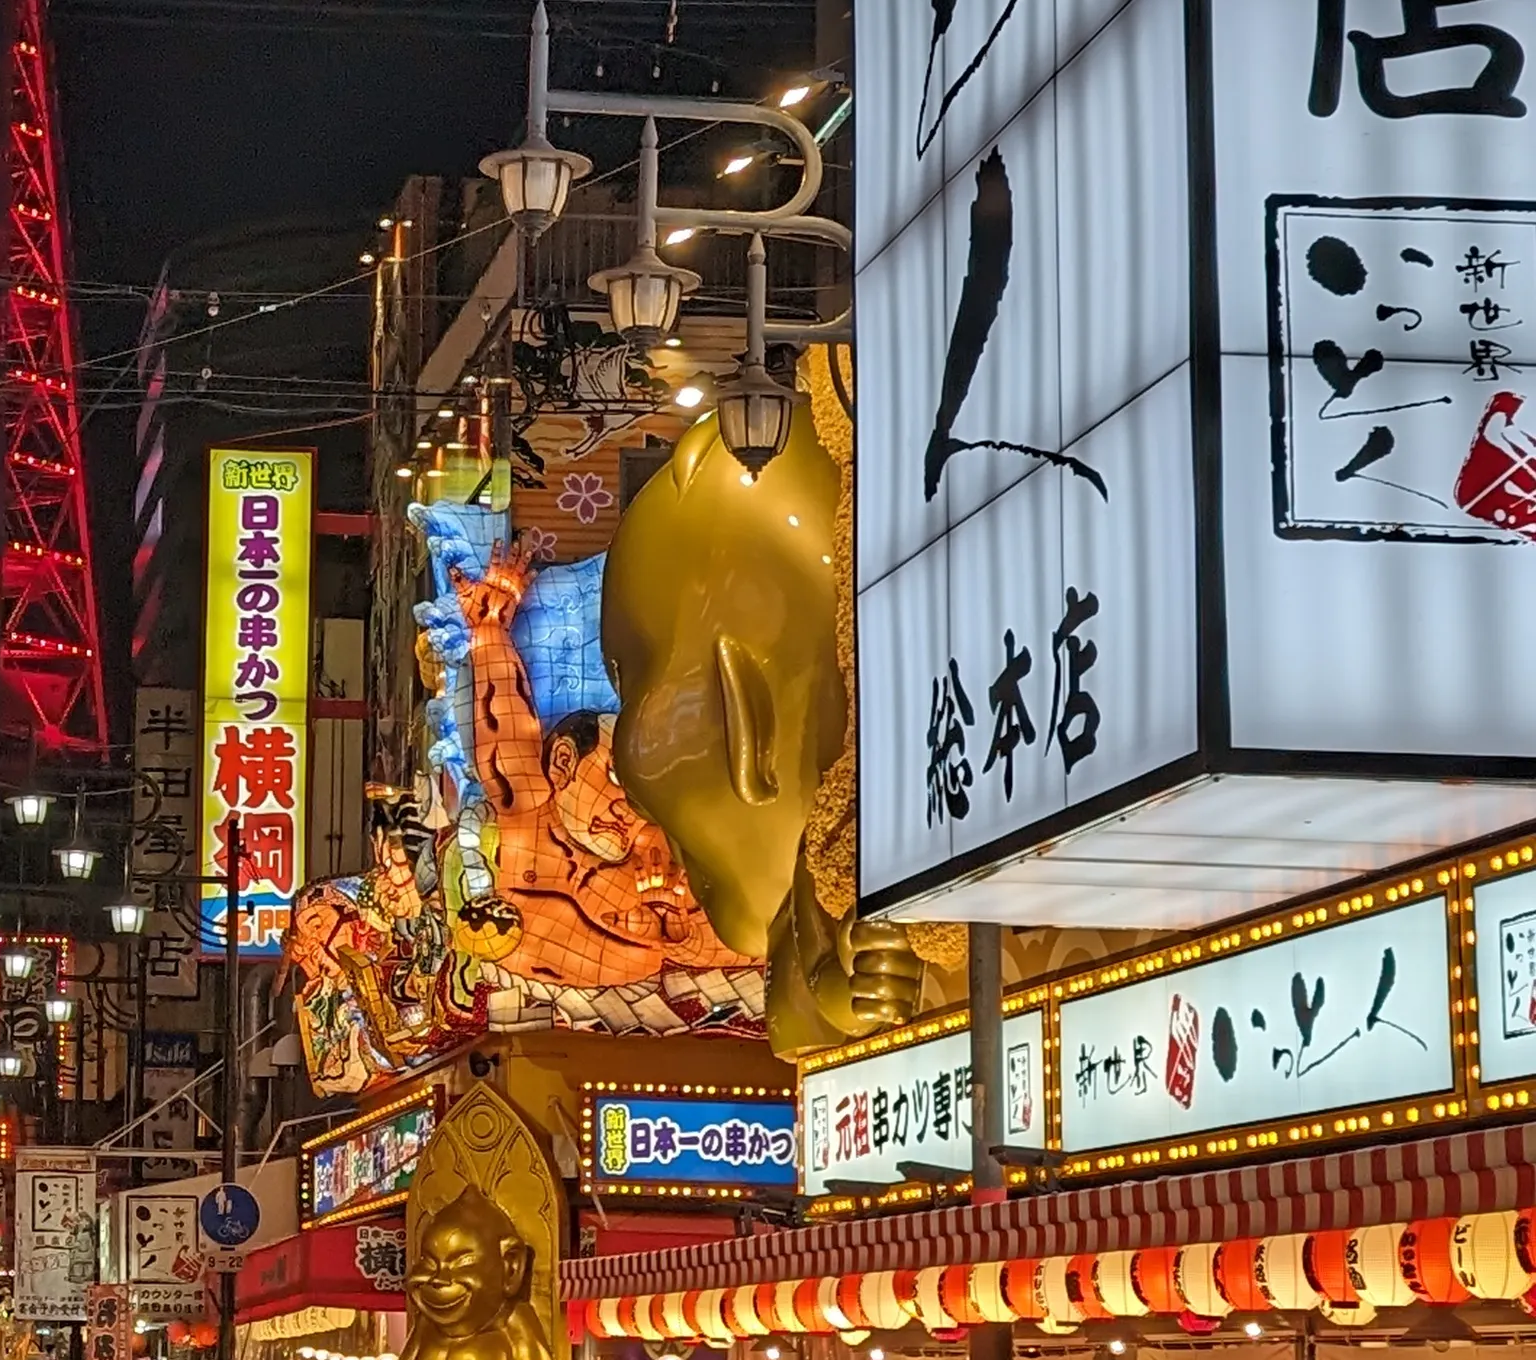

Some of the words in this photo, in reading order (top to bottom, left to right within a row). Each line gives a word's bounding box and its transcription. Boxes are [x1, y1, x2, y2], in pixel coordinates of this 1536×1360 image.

[1455, 245, 1524, 382] 新世界
[222, 461, 298, 490] 新世界
[236, 496, 280, 721] 日本一の串かつ
[924, 586, 1101, 828] 総本店
[212, 725, 296, 894] 横綱
[1074, 1035, 1158, 1109] 新世界
[603, 1107, 626, 1171] 新世界
[630, 1124, 793, 1161] 日本一の串かつ
